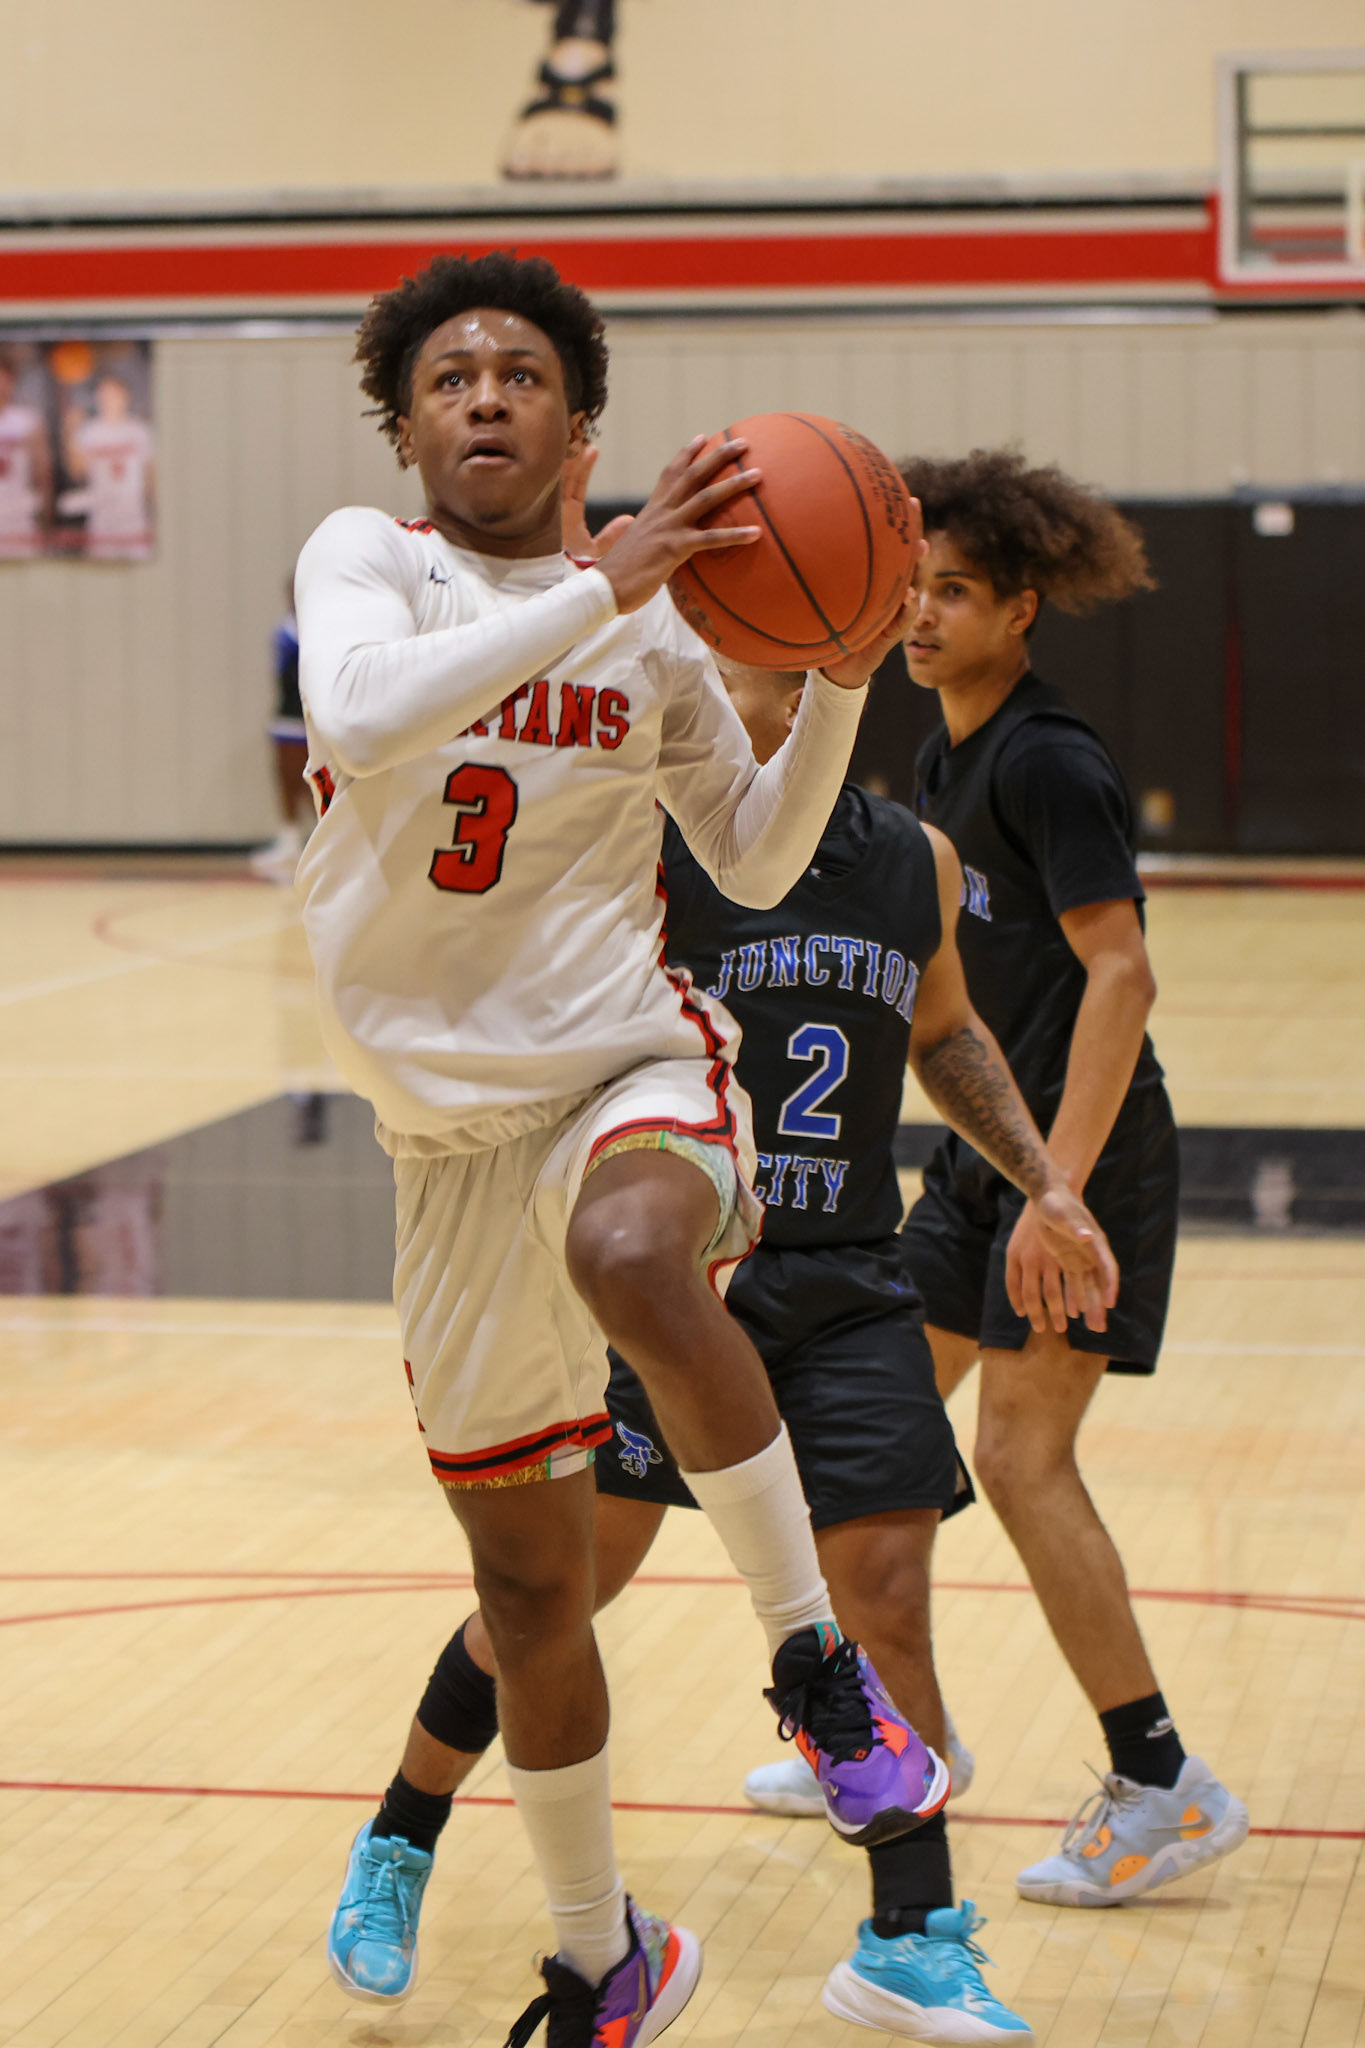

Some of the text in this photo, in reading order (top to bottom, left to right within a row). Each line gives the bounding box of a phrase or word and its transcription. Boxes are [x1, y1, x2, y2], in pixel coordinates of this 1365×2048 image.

[456, 680, 630, 750] TANS
[428, 761, 518, 894] 3
[777, 1022, 849, 1140] 2
